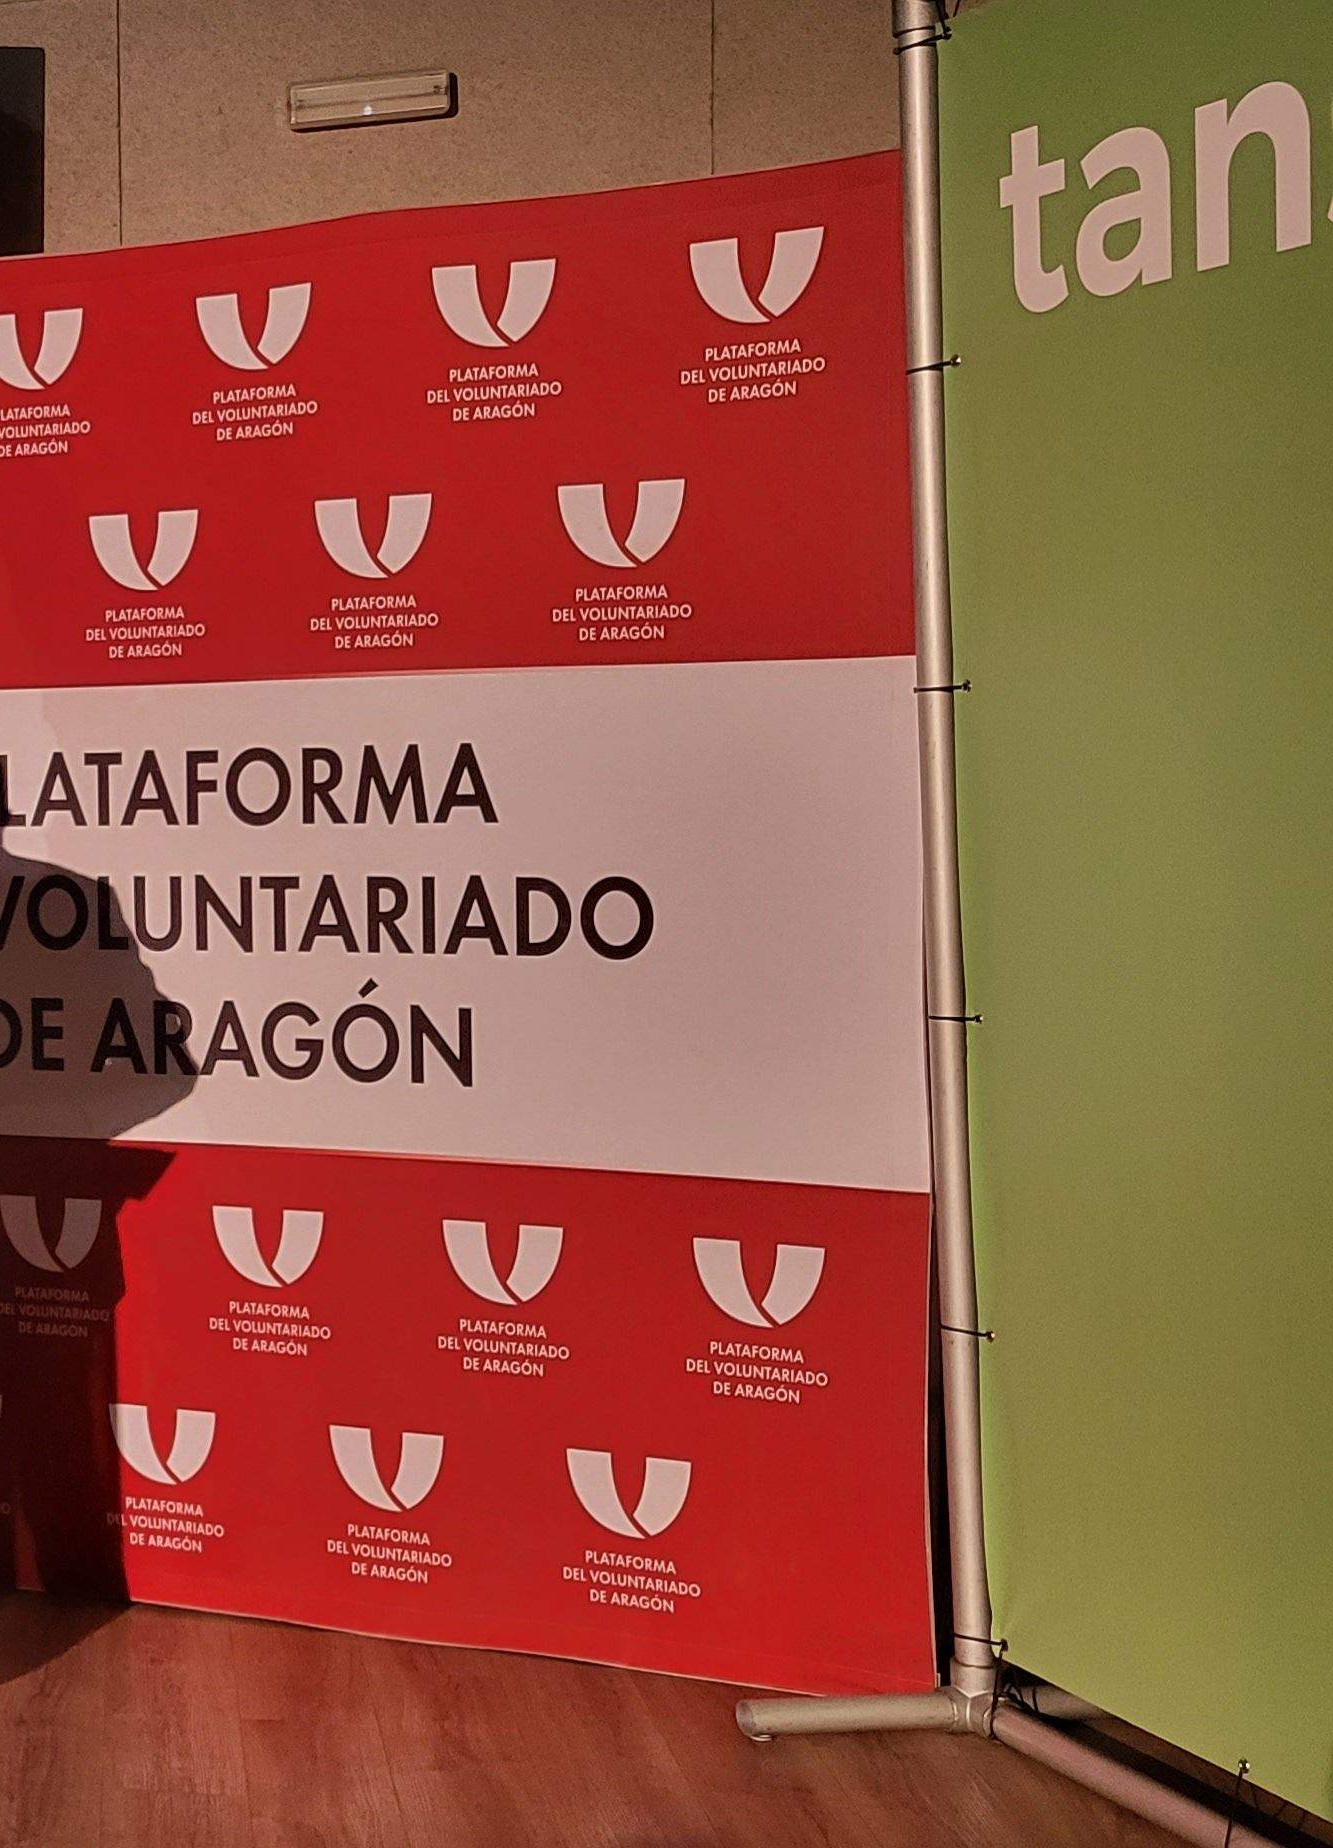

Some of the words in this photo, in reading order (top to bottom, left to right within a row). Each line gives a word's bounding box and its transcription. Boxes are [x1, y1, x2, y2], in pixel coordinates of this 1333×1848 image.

[999, 81, 1333, 313] tan
[706, 339, 801, 360] PLATAFORMA
[450, 363, 538, 382] PLATAFORMA
[681, 370, 705, 384] DEL
[709, 357, 825, 381] VOLUNTARIADO
[213, 384, 296, 404] PLATAFORMA
[427, 390, 450, 403] DEL
[453, 382, 561, 401] VOLUNTARIADO
[709, 388, 726, 402] DE
[730, 381, 796, 401] ARAGÓN
[193, 411, 214, 424] DEL
[217, 401, 317, 422] VOLUNTARIADO
[453, 408, 469, 421] DE
[473, 401, 534, 419] ARAGÓN
[217, 428, 232, 440] DE
[236, 420, 293, 439] ARAGÓN
[15, 439, 67, 456] ARAGÓN
[332, 595, 416, 611] PLATAFORMA
[576, 585, 667, 601] PLATAFORMA
[106, 607, 184, 622] PLATAFORMA
[311, 618, 332, 630] DEL
[336, 613, 438, 629] VOLUNTARIADO
[553, 609, 576, 622] DEL
[580, 604, 691, 621] VOLUNTARIADO
[86, 629, 106, 641] DEL
[109, 624, 205, 639] VOLUNTARIADO
[335, 636, 350, 648] DE
[354, 631, 413, 648] ARAGÓN
[580, 628, 596, 640] DE
[600, 623, 664, 640] ARAGÓN
[109, 646, 124, 658] DE
[127, 641, 181, 657] ARAGÓN
[89, 979, 474, 1088] ARAGÓN
[230, 1301, 309, 1319] PLATAFORMA
[210, 1318, 230, 1331] DEL
[233, 1320, 330, 1339] VOLUNTARIADO
[460, 1319, 546, 1338] PLATAFORMA
[233, 1338, 248, 1350] DE
[252, 1340, 307, 1355] ARAGÓN
[438, 1336, 460, 1349] DEL
[464, 1338, 569, 1359] VOLUNTARIADO
[710, 1342, 803, 1363] PLATAFORMA
[464, 1357, 479, 1370] DE
[483, 1359, 543, 1376] ARAGÓN
[687, 1359, 710, 1373] DEL
[714, 1362, 828, 1386] VOLUNTARIADO
[714, 1381, 730, 1395] DE
[735, 1384, 799, 1403] ARAGÓN
[126, 1497, 203, 1517] PLATAFORMA
[129, 1515, 224, 1537] VOLUNTARIADO
[348, 1524, 430, 1545] PLATAFORMA
[130, 1533, 144, 1545] DE
[148, 1535, 201, 1552] ARAGÓN
[327, 1540, 349, 1554] DEL
[352, 1544, 452, 1567] VOLUNTARIADO
[586, 1550, 676, 1574] PLATAFORMA
[352, 1562, 367, 1575] DE
[371, 1565, 427, 1583] ARAGÓN
[563, 1567, 586, 1581] DEL
[590, 1570, 700, 1597] VOLUNTARIADO
[590, 1589, 606, 1603] DE
[611, 1592, 674, 1613] ARAGÓN
